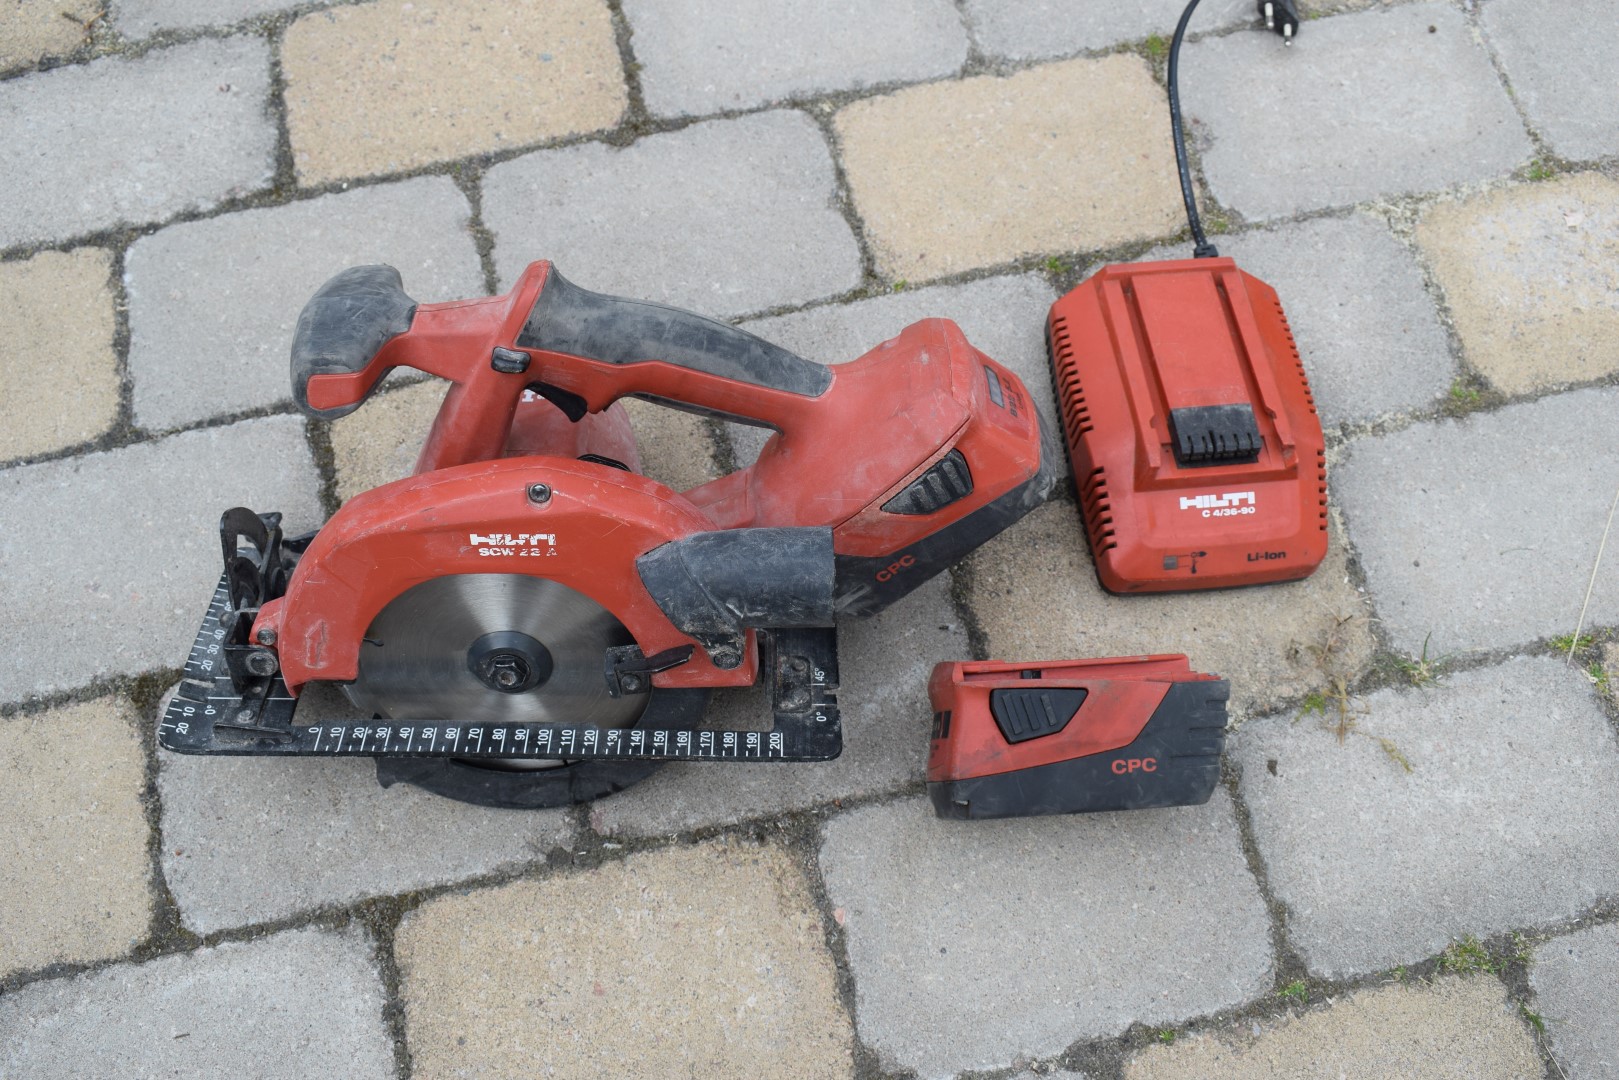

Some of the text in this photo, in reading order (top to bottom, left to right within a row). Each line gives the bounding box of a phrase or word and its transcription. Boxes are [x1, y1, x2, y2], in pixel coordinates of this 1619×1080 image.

[1180, 491, 1255, 509] HILTI
[1202, 507, 1255, 517] C 4/36-90
[479, 548, 515, 556] SCW
[1247, 550, 1286, 562] Li-Ion
[875, 554, 916, 582] CPC
[213, 629, 225, 640] 40
[207, 644, 220, 654] 30
[201, 660, 213, 671] 20
[183, 707, 195, 717] 10
[176, 722, 189, 734] 20
[330, 727, 342, 738] 10
[353, 727, 365, 739] 20
[375, 727, 388, 739] 30
[398, 727, 411, 739] 40
[422, 727, 434, 739] 50
[445, 727, 457, 739] 60
[468, 728, 480, 740] 70
[492, 728, 503, 740] 80
[514, 729, 527, 741] 90
[537, 729, 549, 746] 100
[560, 730, 573, 746] 110
[584, 730, 596, 746] 120
[630, 730, 642, 747] 140
[654, 730, 665, 748] 150
[677, 731, 688, 748] 160
[700, 732, 711, 748] 170
[724, 732, 734, 748] 180
[747, 732, 758, 749] 190
[769, 732, 780, 749] 200
[1111, 757, 1158, 775] CPC
